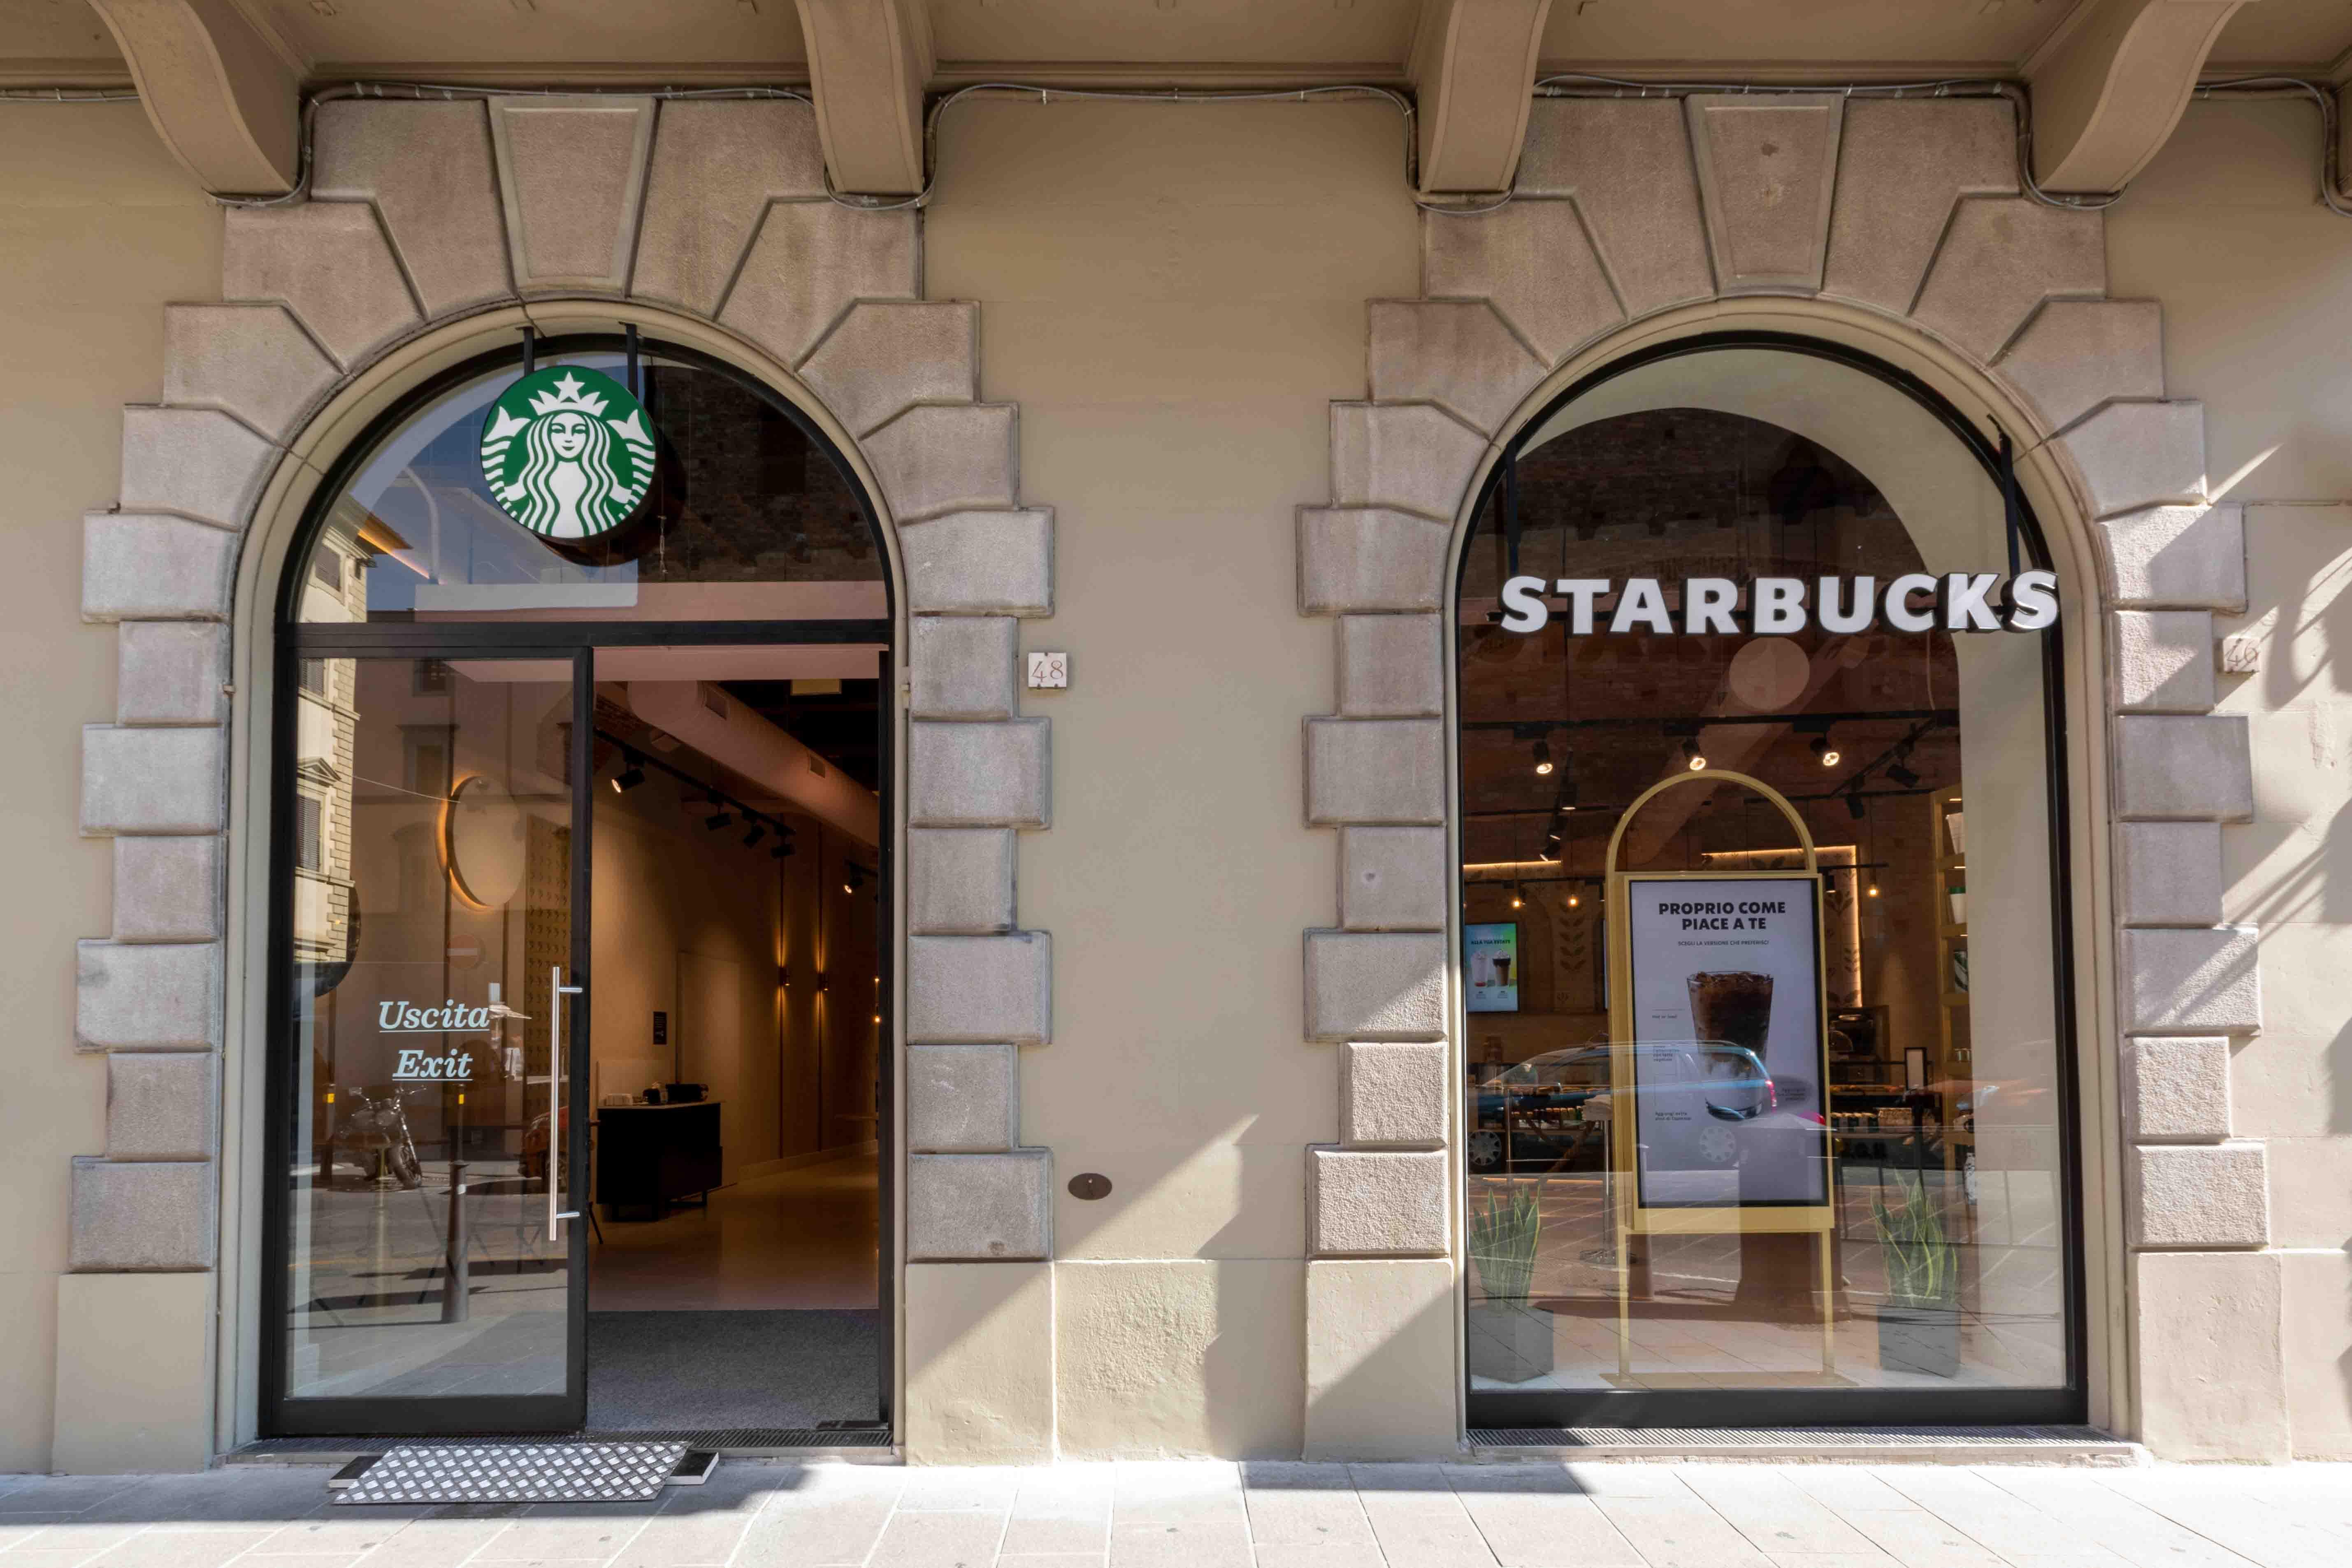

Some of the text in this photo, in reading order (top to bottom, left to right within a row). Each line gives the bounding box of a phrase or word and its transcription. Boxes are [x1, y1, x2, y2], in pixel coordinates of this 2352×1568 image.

[1500, 569, 2058, 635] STARBUCKS
[2227, 639, 2258, 666] 46
[1031, 660, 1063, 683] 48
[1658, 901, 1786, 915] PROPRIO COME
[1682, 917, 1767, 930] PIACE A TE
[379, 999, 490, 1029] Uscita
[392, 1049, 473, 1078] Exit
